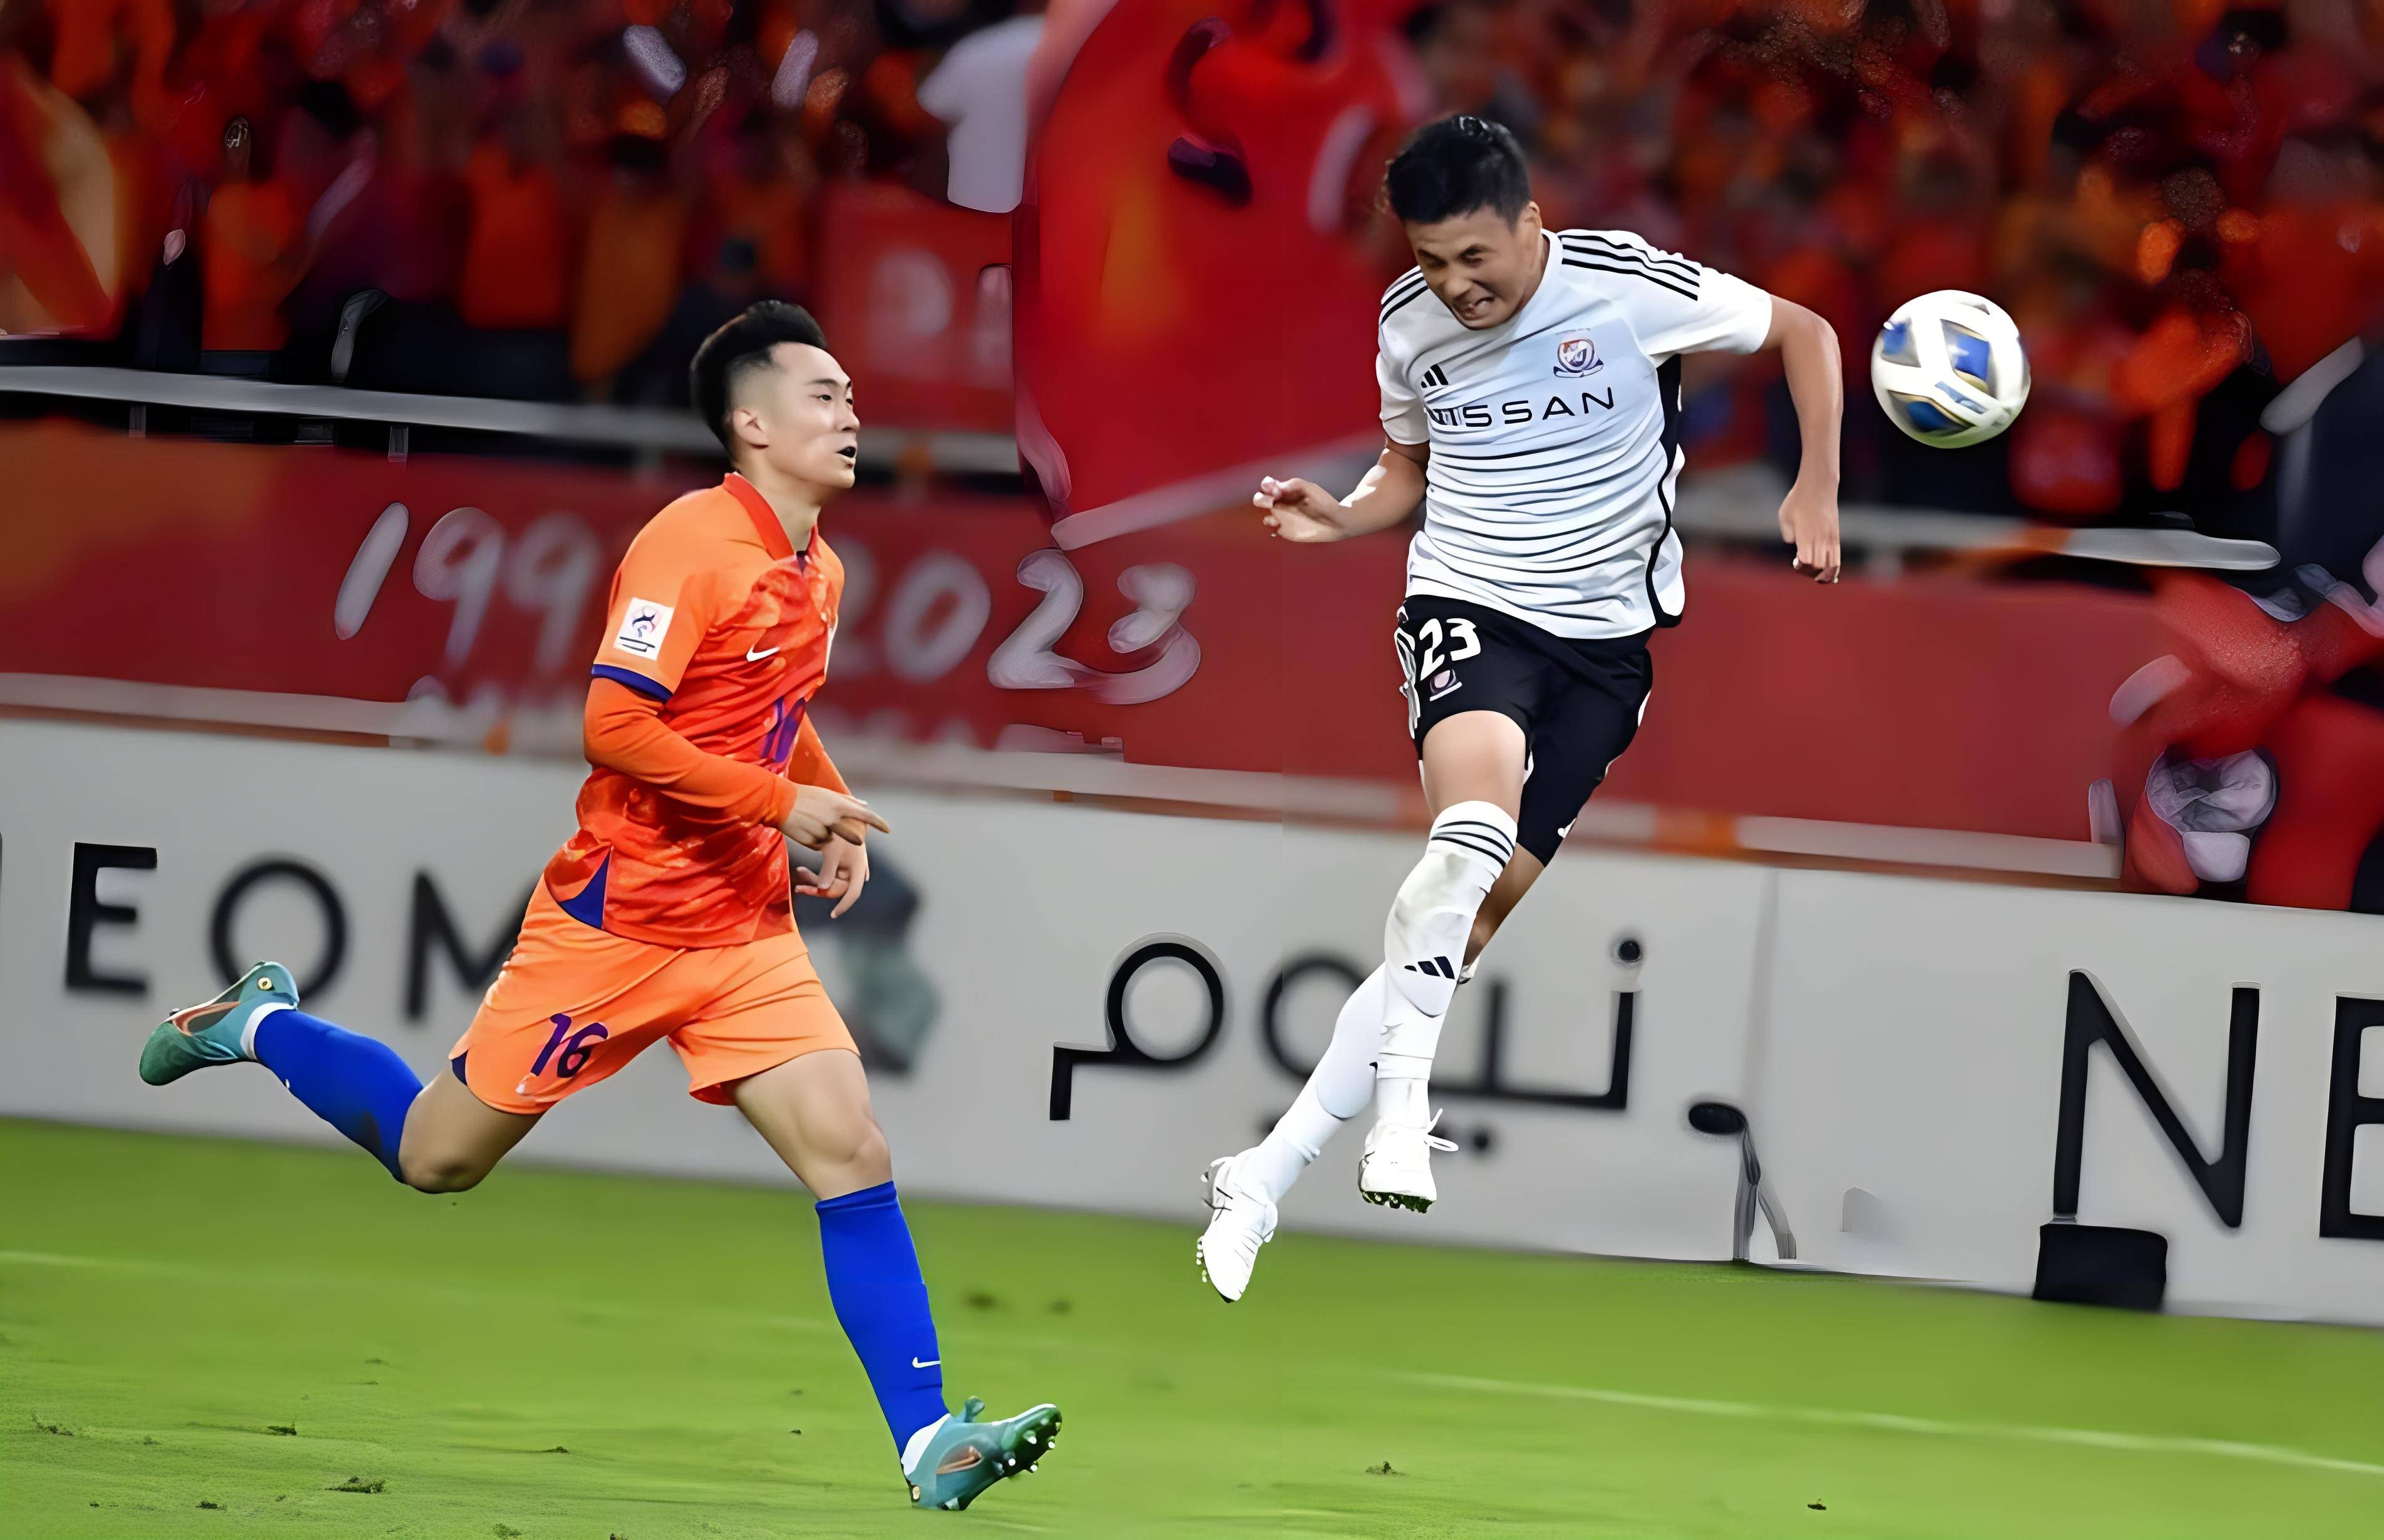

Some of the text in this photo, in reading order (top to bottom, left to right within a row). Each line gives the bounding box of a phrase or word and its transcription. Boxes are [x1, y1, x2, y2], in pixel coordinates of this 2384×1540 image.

[334, 502, 602, 677] 199
[1419, 618, 1482, 681] 23
[0, 831, 537, 1023] EOM
[530, 1012, 609, 1079] 16
